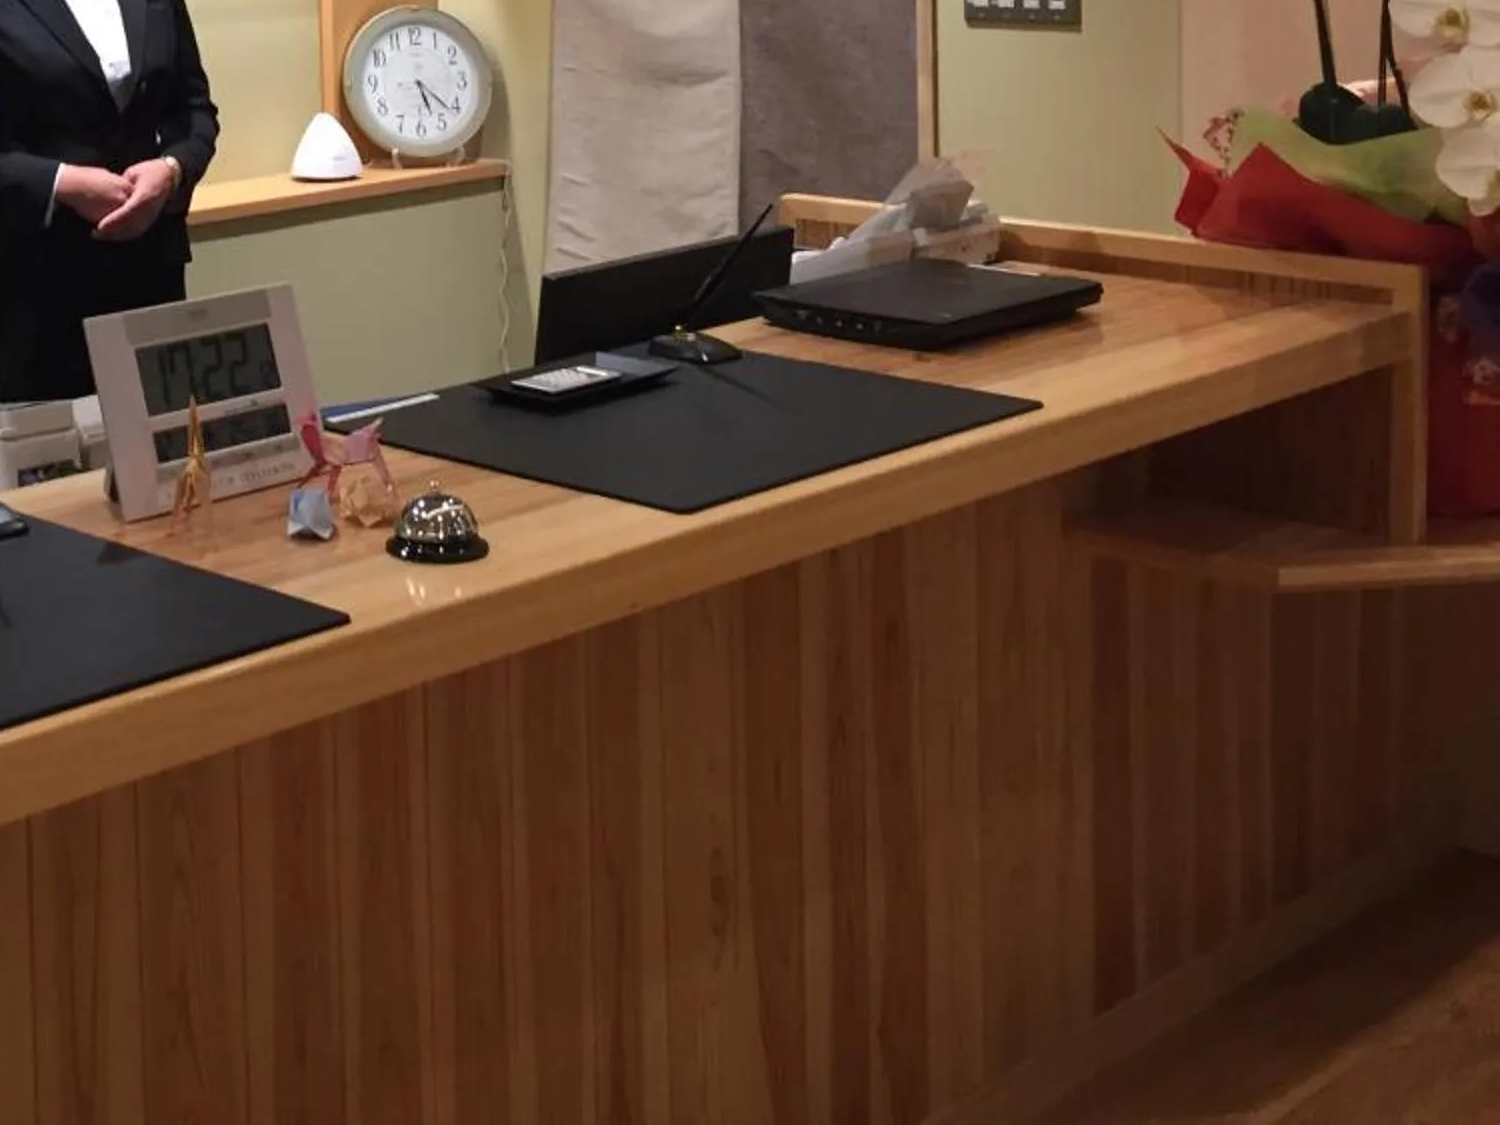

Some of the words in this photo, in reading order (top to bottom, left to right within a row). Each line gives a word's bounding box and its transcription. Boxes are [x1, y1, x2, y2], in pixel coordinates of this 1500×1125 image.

[389, 32, 401, 50] 11
[407, 26, 421, 46] 12
[372, 49, 387, 68] 10
[447, 45, 458, 65] 2
[367, 74, 379, 94] 9
[456, 71, 468, 90] 3
[376, 97, 389, 116] 8
[451, 95, 461, 115] 4
[395, 114, 405, 134] 7
[415, 119, 427, 138] 6
[437, 113, 447, 131] 5
